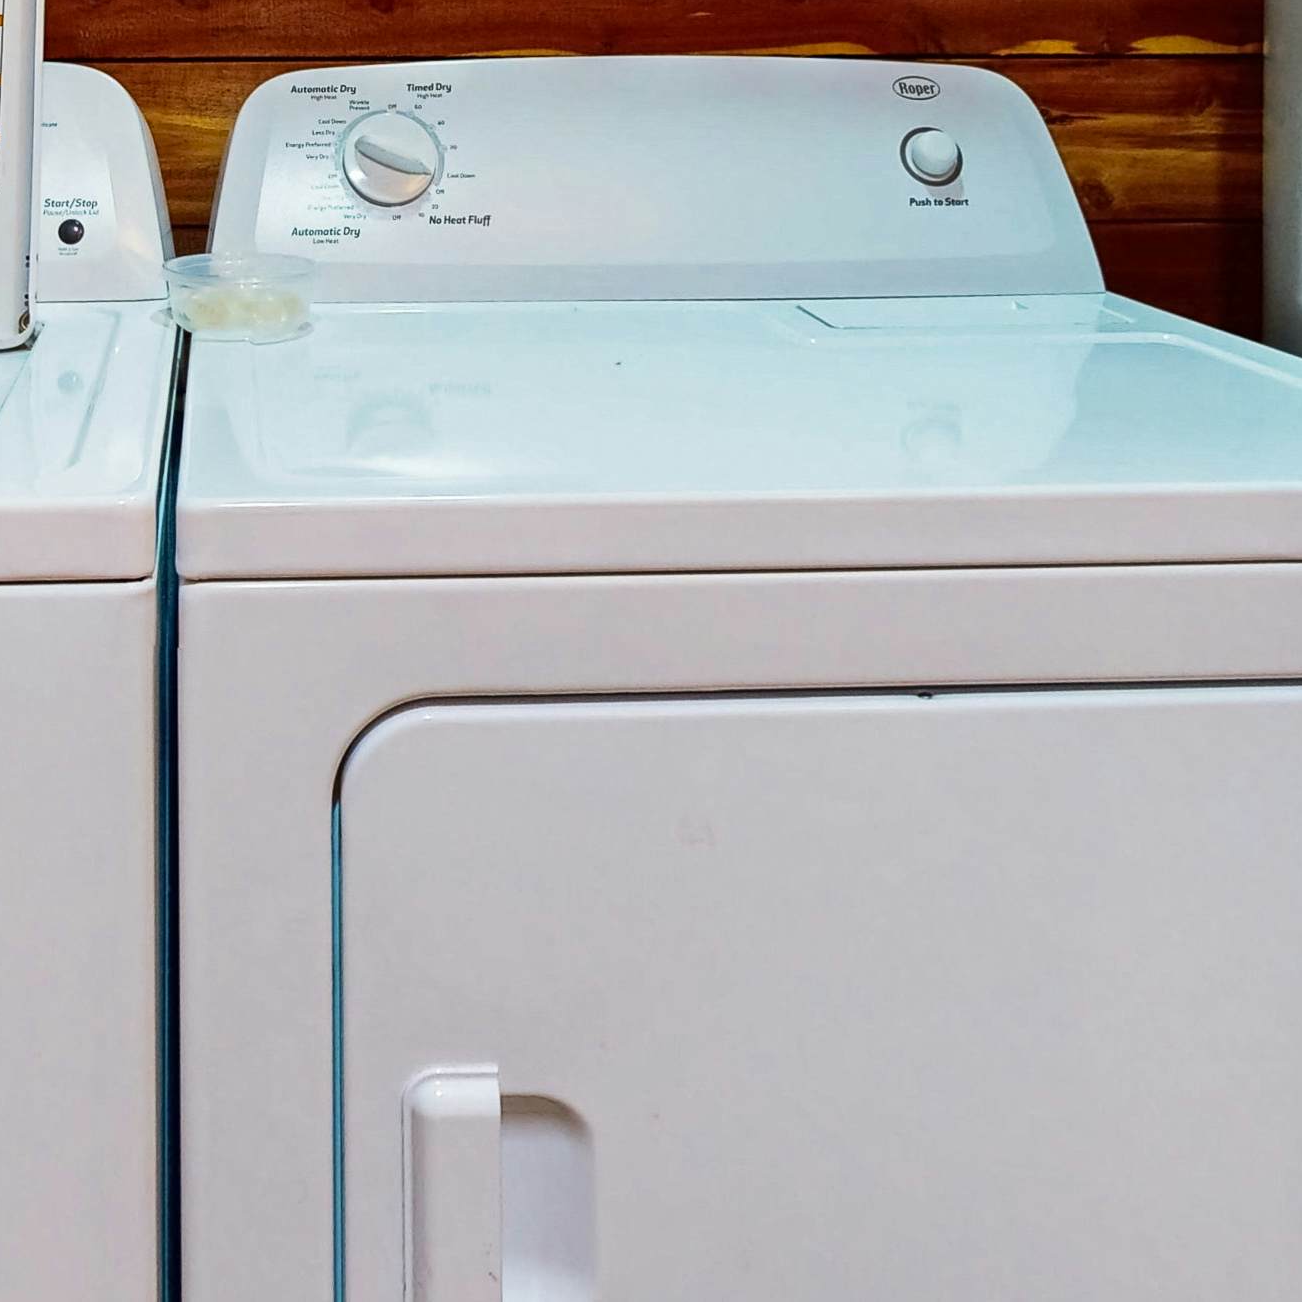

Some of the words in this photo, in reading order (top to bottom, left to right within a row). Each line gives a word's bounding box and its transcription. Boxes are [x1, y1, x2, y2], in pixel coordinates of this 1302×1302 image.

[291, 85, 338, 94] Automatic
[340, 84, 357, 95] Dry
[406, 83, 434, 92] Timed
[435, 82, 452, 93] Dry
[898, 82, 935, 96] Roper
[44, 198, 98, 209] Start/Stop
[909, 198, 932, 206] Push
[934, 198, 943, 206] to
[945, 197, 969, 206] Start
[429, 216, 442, 224] No
[443, 216, 466, 224] Heat
[468, 215, 491, 226] Fluff
[291, 227, 341, 236] Automatic
[343, 227, 360, 238] Dry
